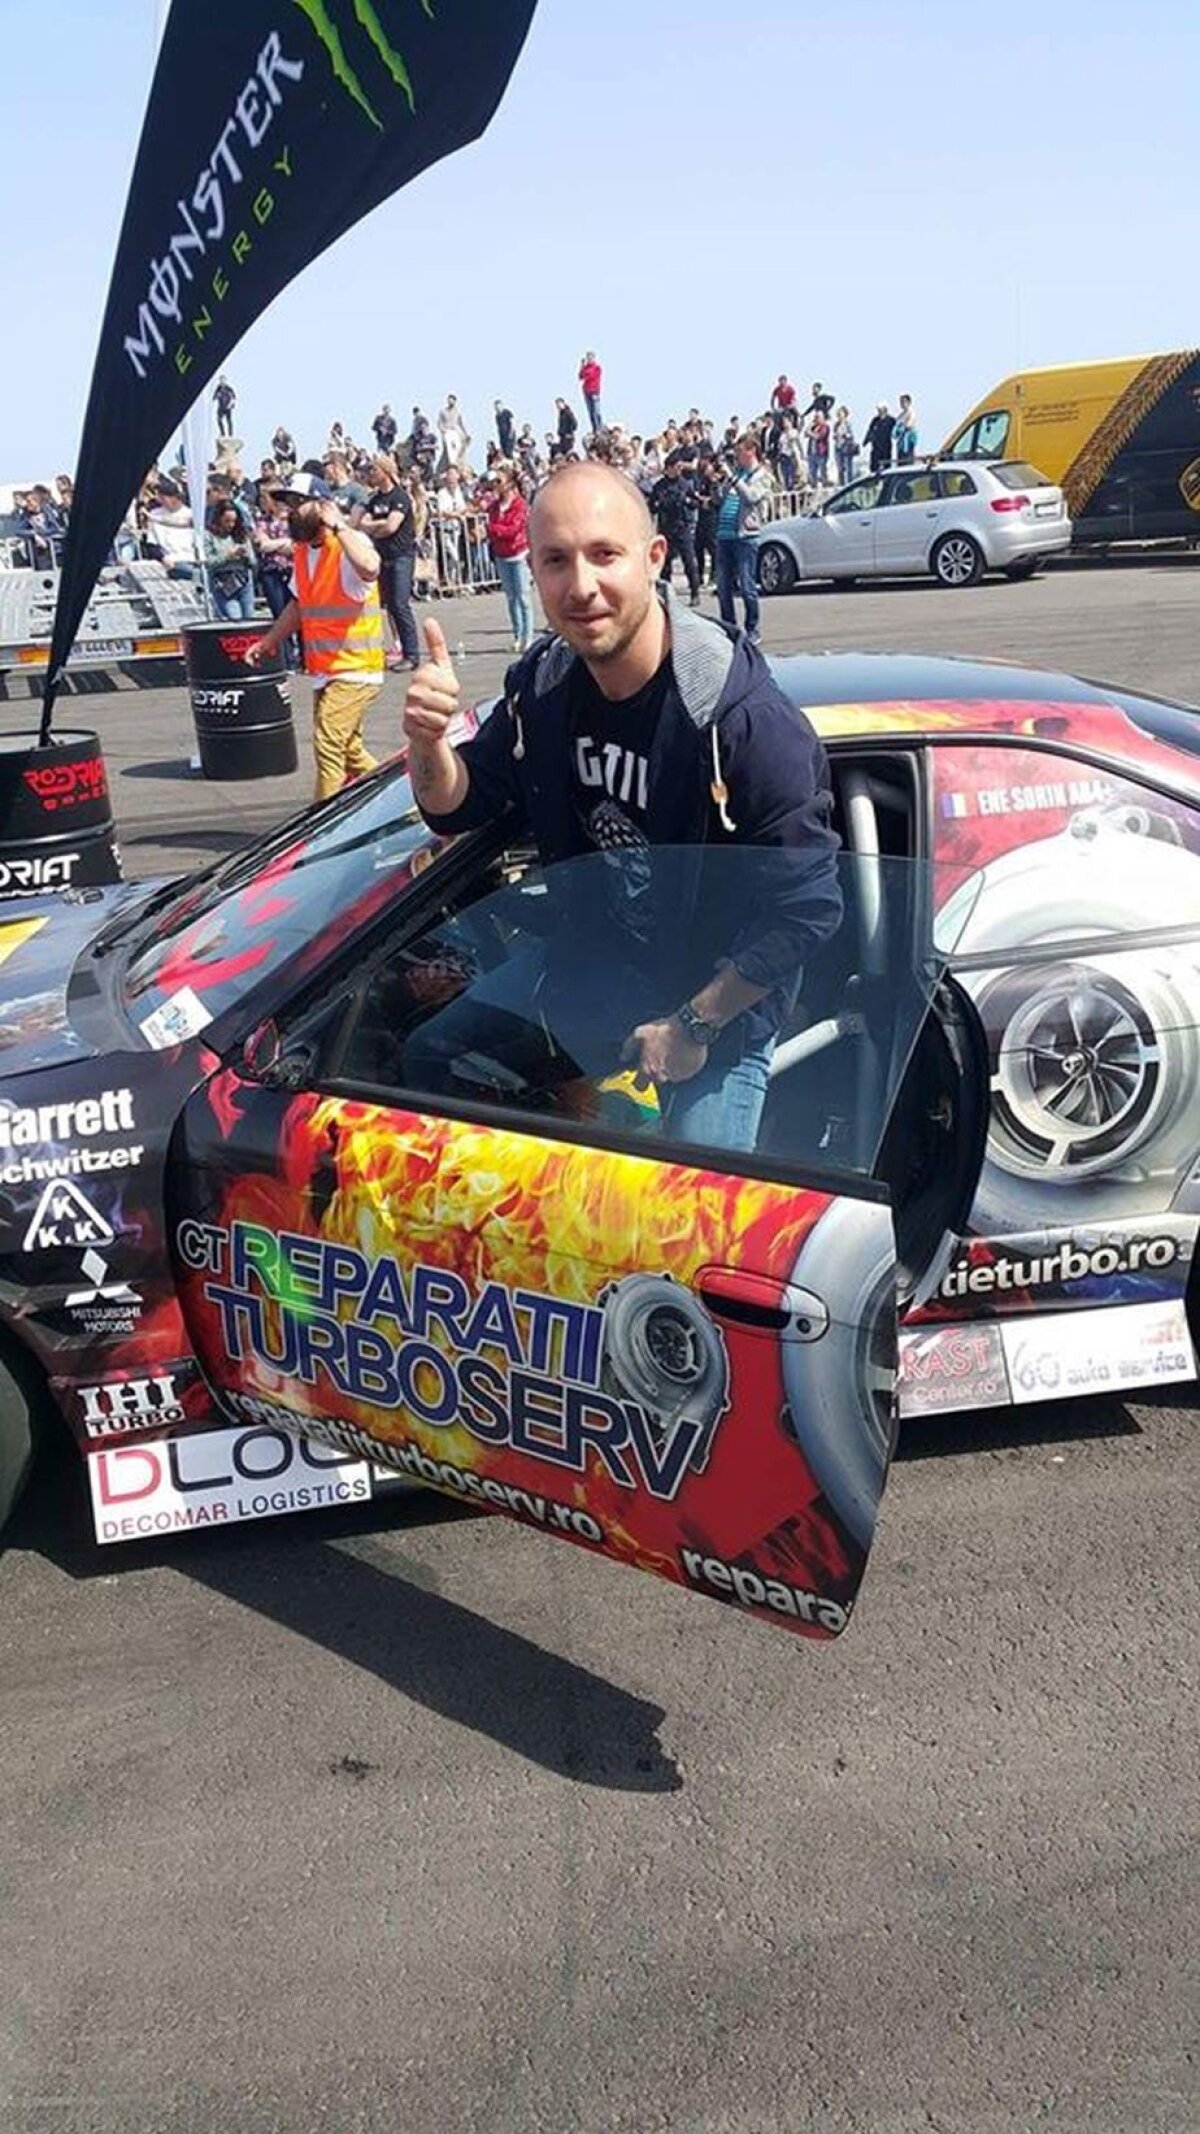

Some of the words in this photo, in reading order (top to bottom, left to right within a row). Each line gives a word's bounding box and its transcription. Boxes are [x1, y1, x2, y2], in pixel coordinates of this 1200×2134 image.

[174, 145, 295, 375] ENERGY
[1011, 782, 1067, 811] SORIN
[0, 1145, 144, 1184] chwitzer
[52, 1196, 76, 1220] K
[931, 1238, 1176, 1299] tieturbo.ro
[71, 1306, 142, 1320] MITSUBISHI
[84, 1320, 135, 1333] MOTORS
[177, 1218, 228, 1275] CT
[230, 1220, 605, 1389] REPARATII
[78, 1375, 181, 1421] IHI
[204, 1283, 703, 1501] TURBOSERV
[88, 1407, 184, 1436] TURBO
[102, 1503, 230, 1540] DECOMAR
[238, 1479, 368, 1516] LOGISTICS
[681, 1548, 854, 1632] repara
